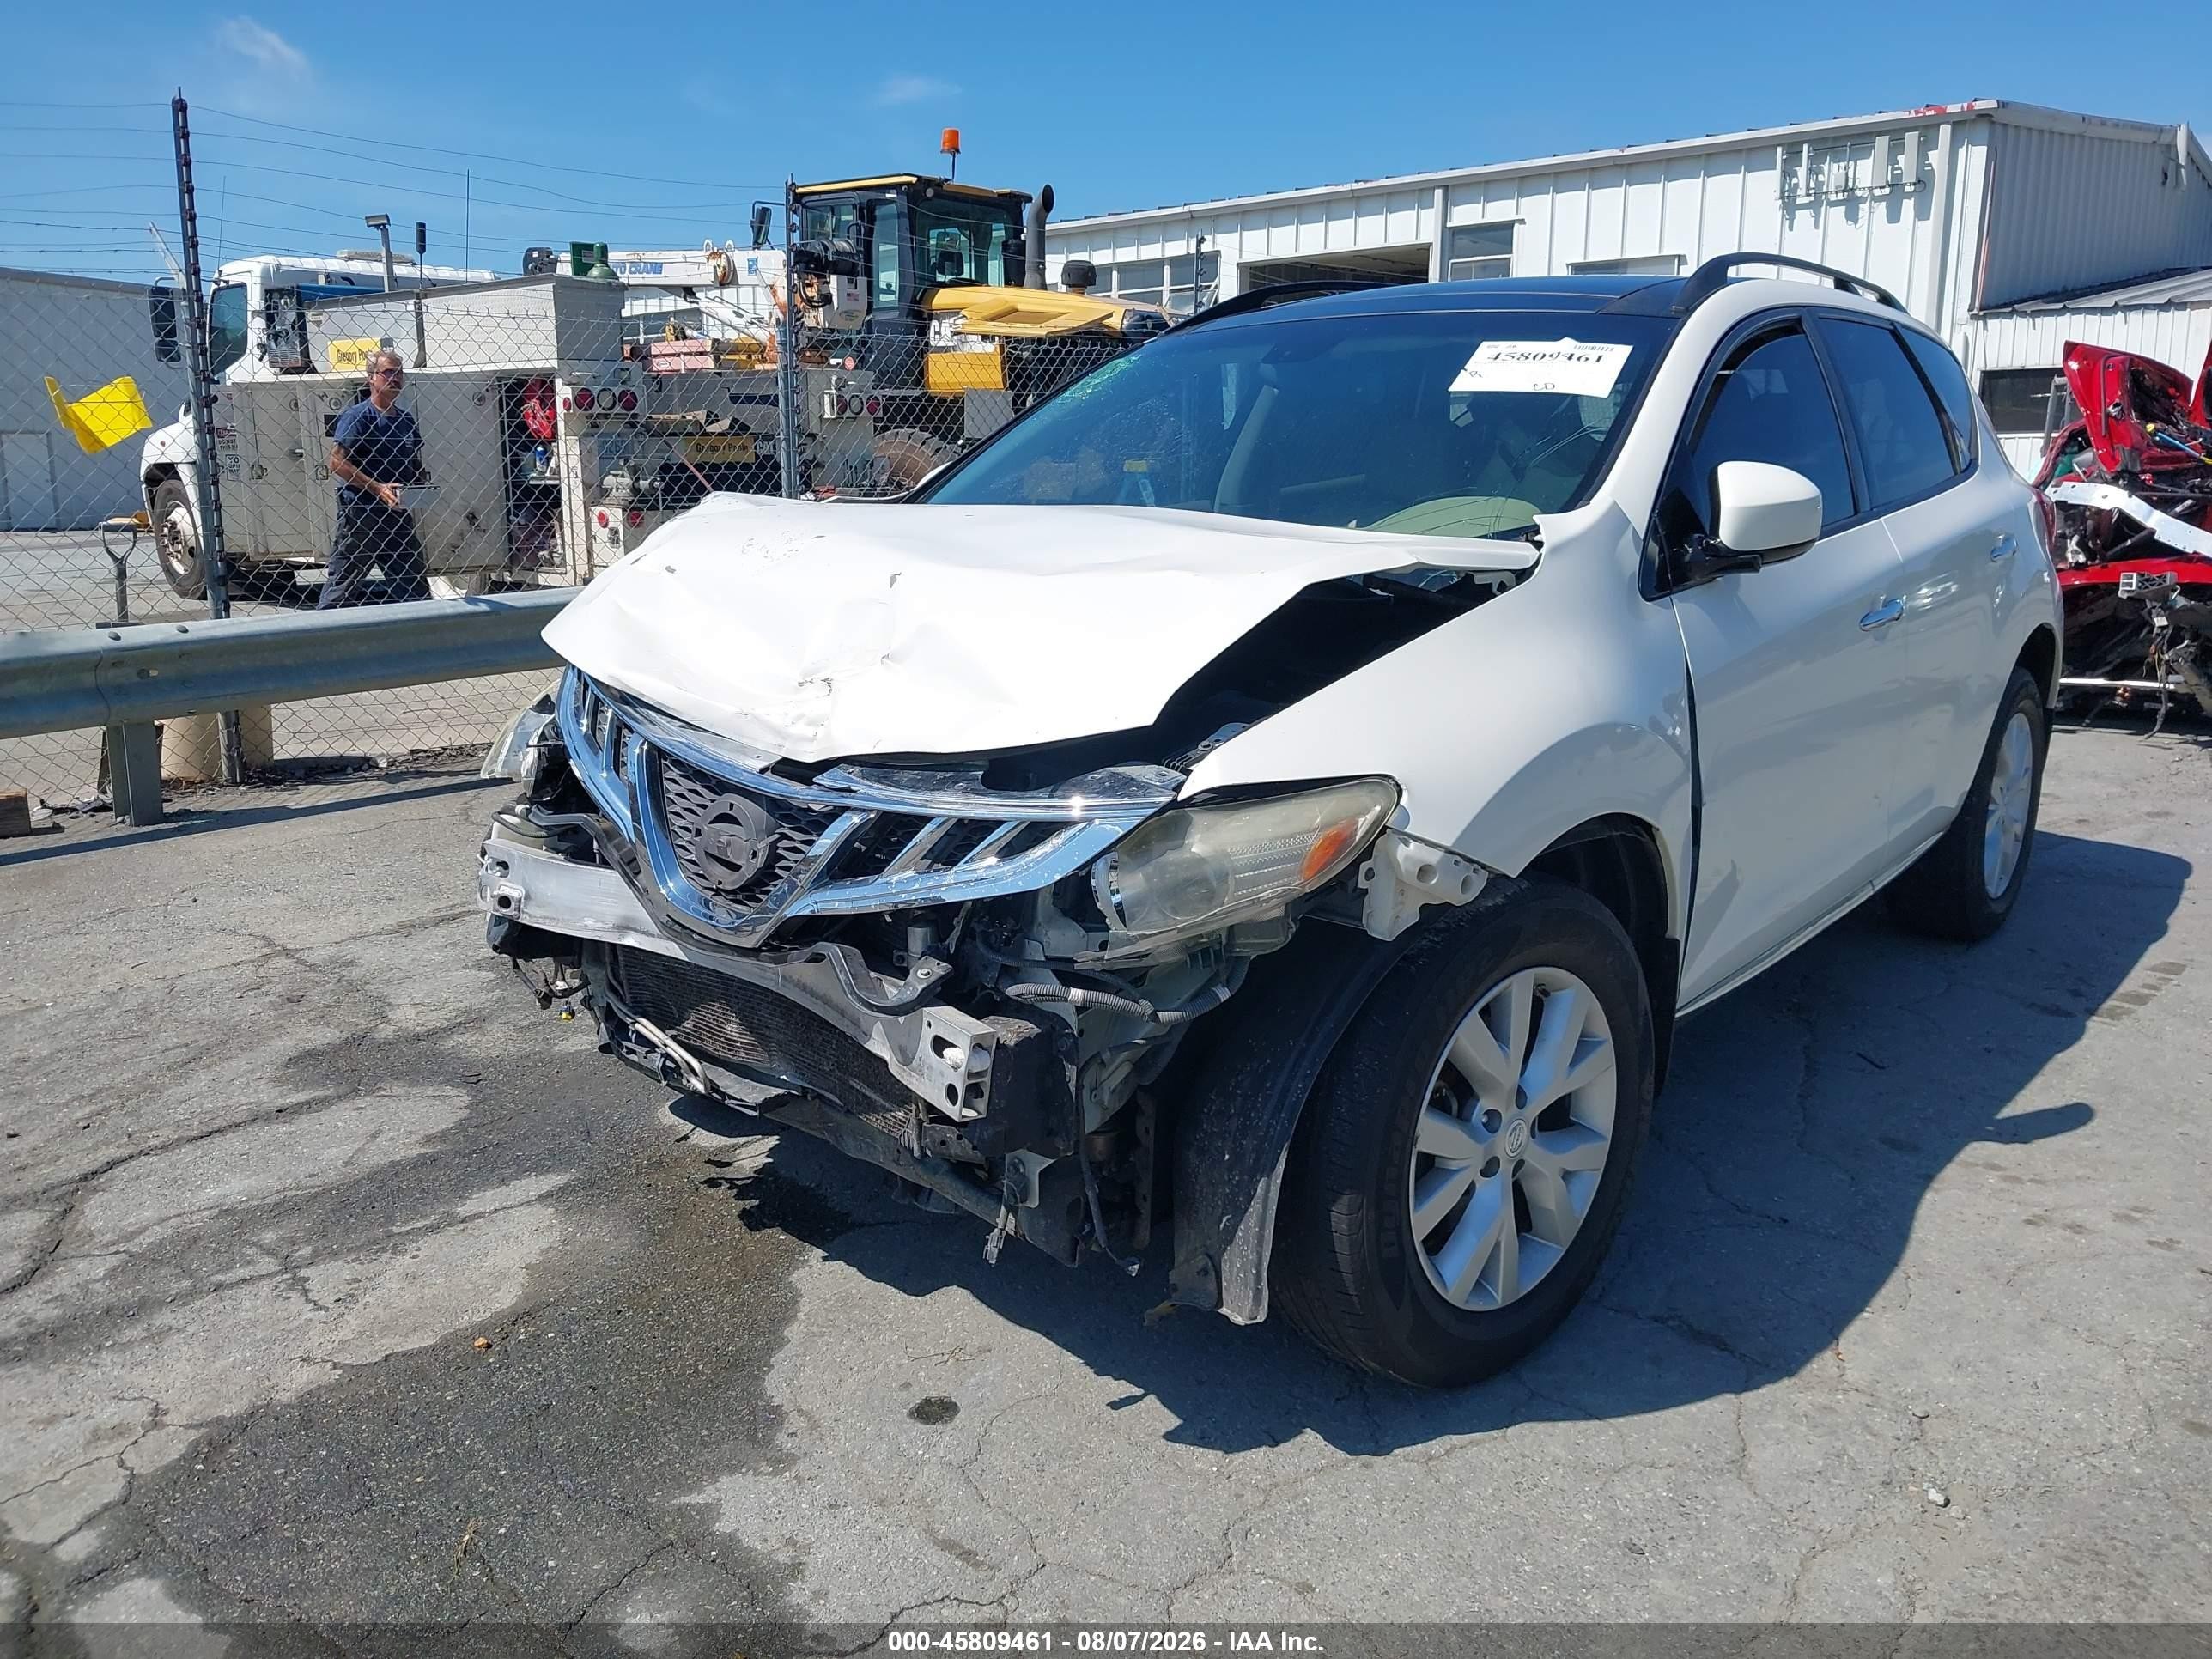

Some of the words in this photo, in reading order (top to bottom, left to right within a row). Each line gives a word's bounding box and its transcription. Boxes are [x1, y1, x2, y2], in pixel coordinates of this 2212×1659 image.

[611, 262, 627, 275] TO
[628, 262, 664, 275] CRANE
[337, 350, 357, 365] Gregory
[1487, 351, 1604, 364] 45809461
[696, 443, 726, 454] Gregory
